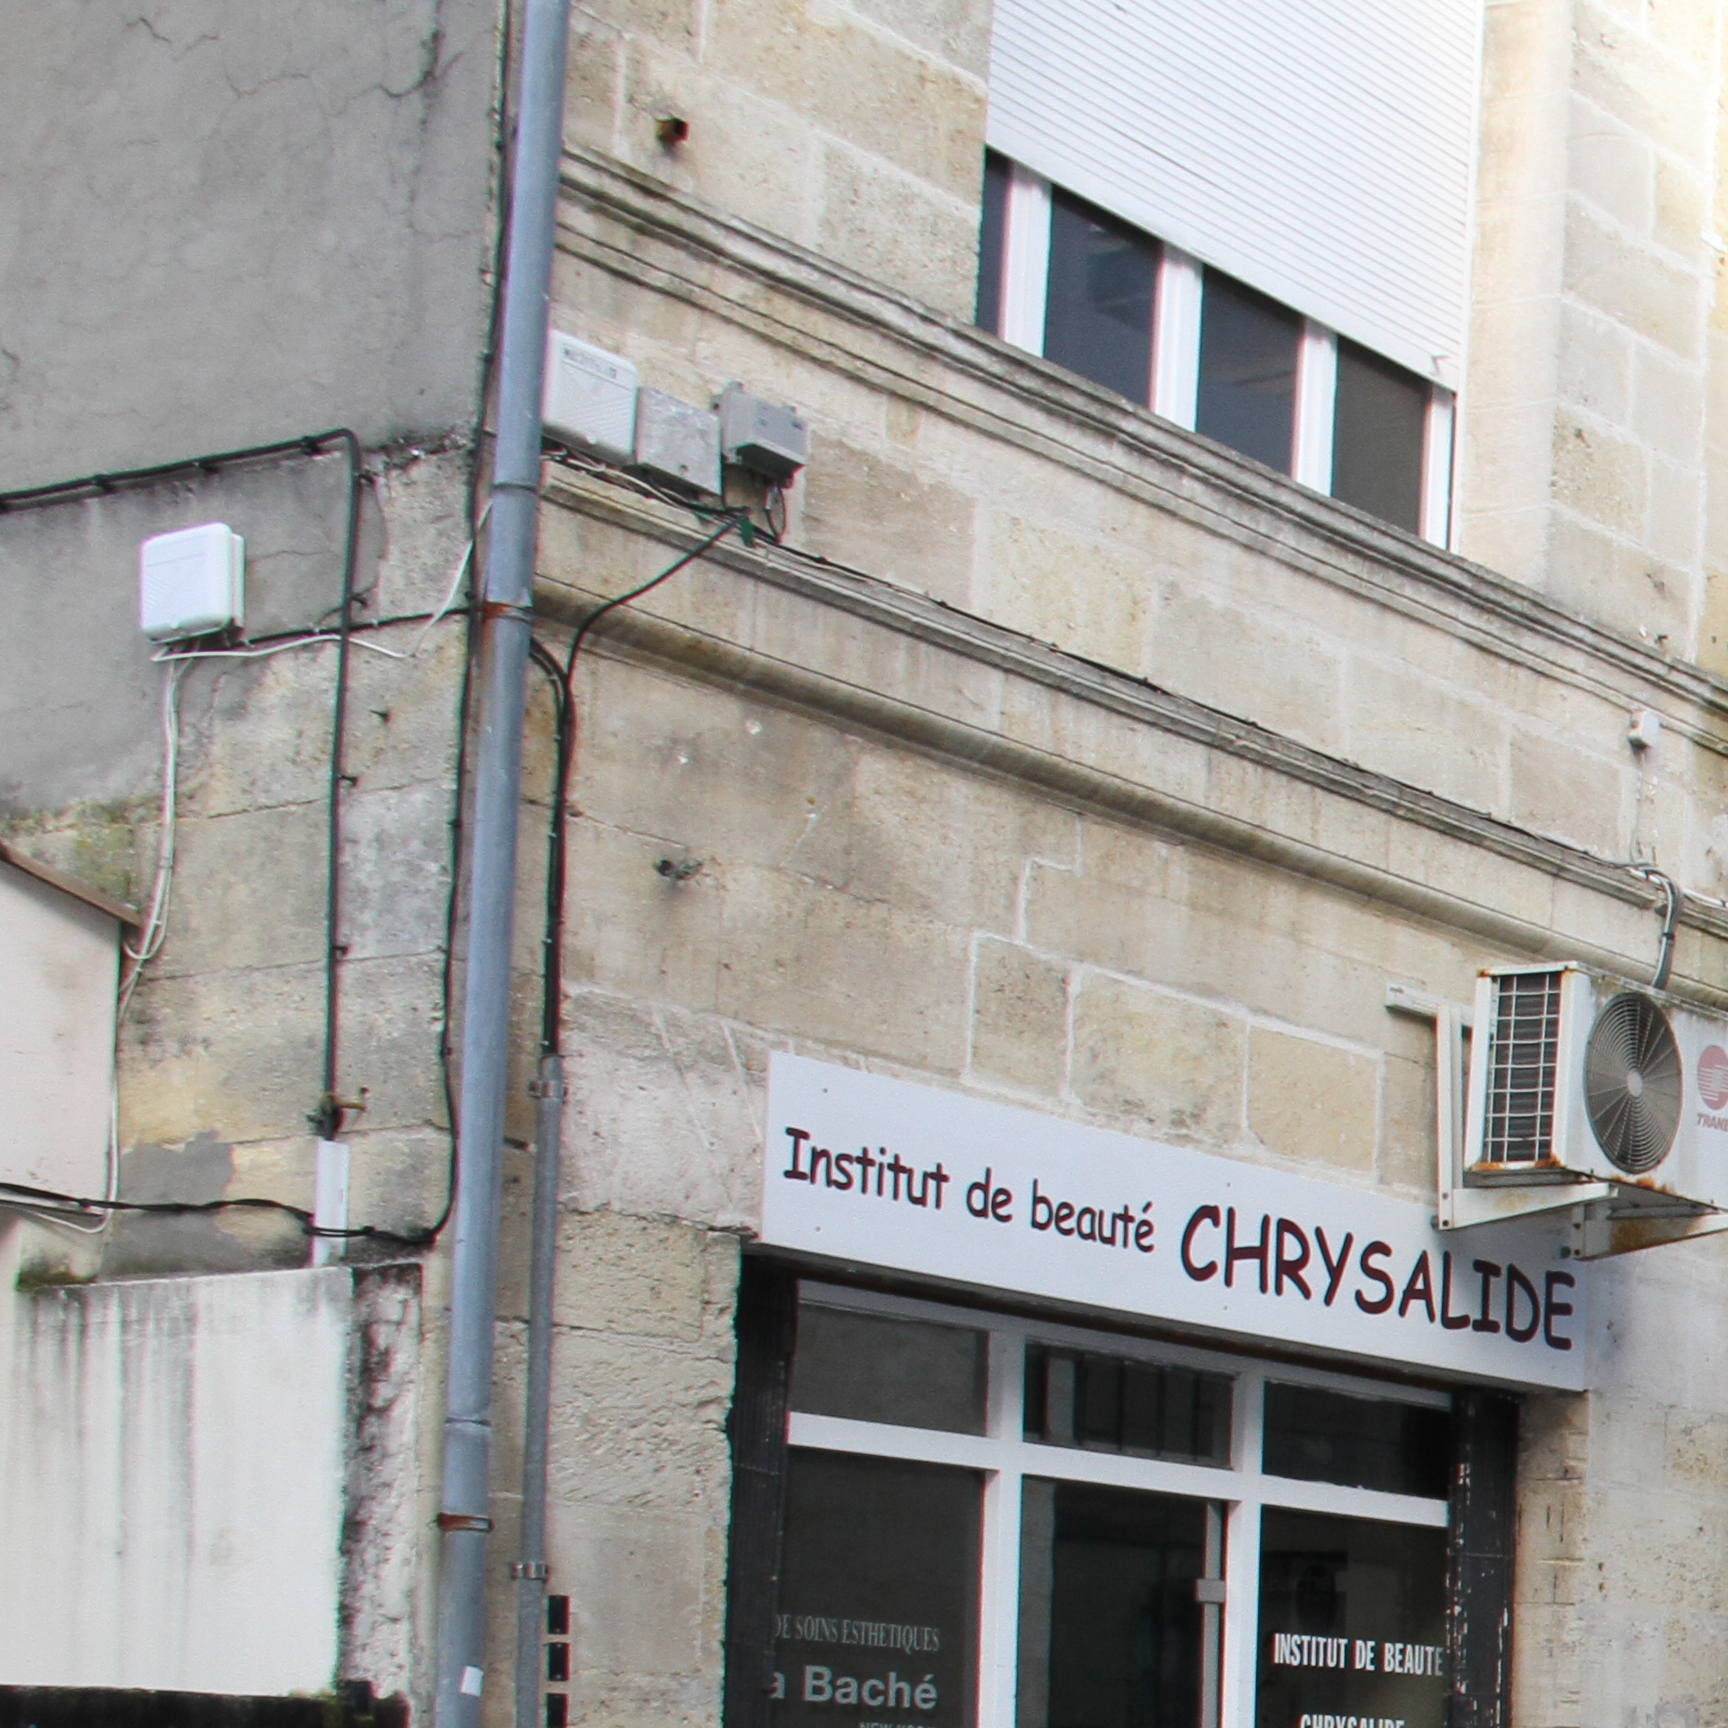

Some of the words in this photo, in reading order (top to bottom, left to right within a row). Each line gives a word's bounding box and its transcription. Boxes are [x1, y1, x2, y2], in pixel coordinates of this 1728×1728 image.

[783, 1126, 949, 1210] Institut
[966, 1166, 1013, 1223] de
[1030, 1178, 1155, 1252] beauté
[1180, 1204, 1574, 1349] CHRYSALIDE
[796, 1616, 839, 1643] SOINS
[1273, 1632, 1348, 1669] INSTITUT
[1355, 1639, 1376, 1671] DE
[803, 1664, 938, 1710] Baché
